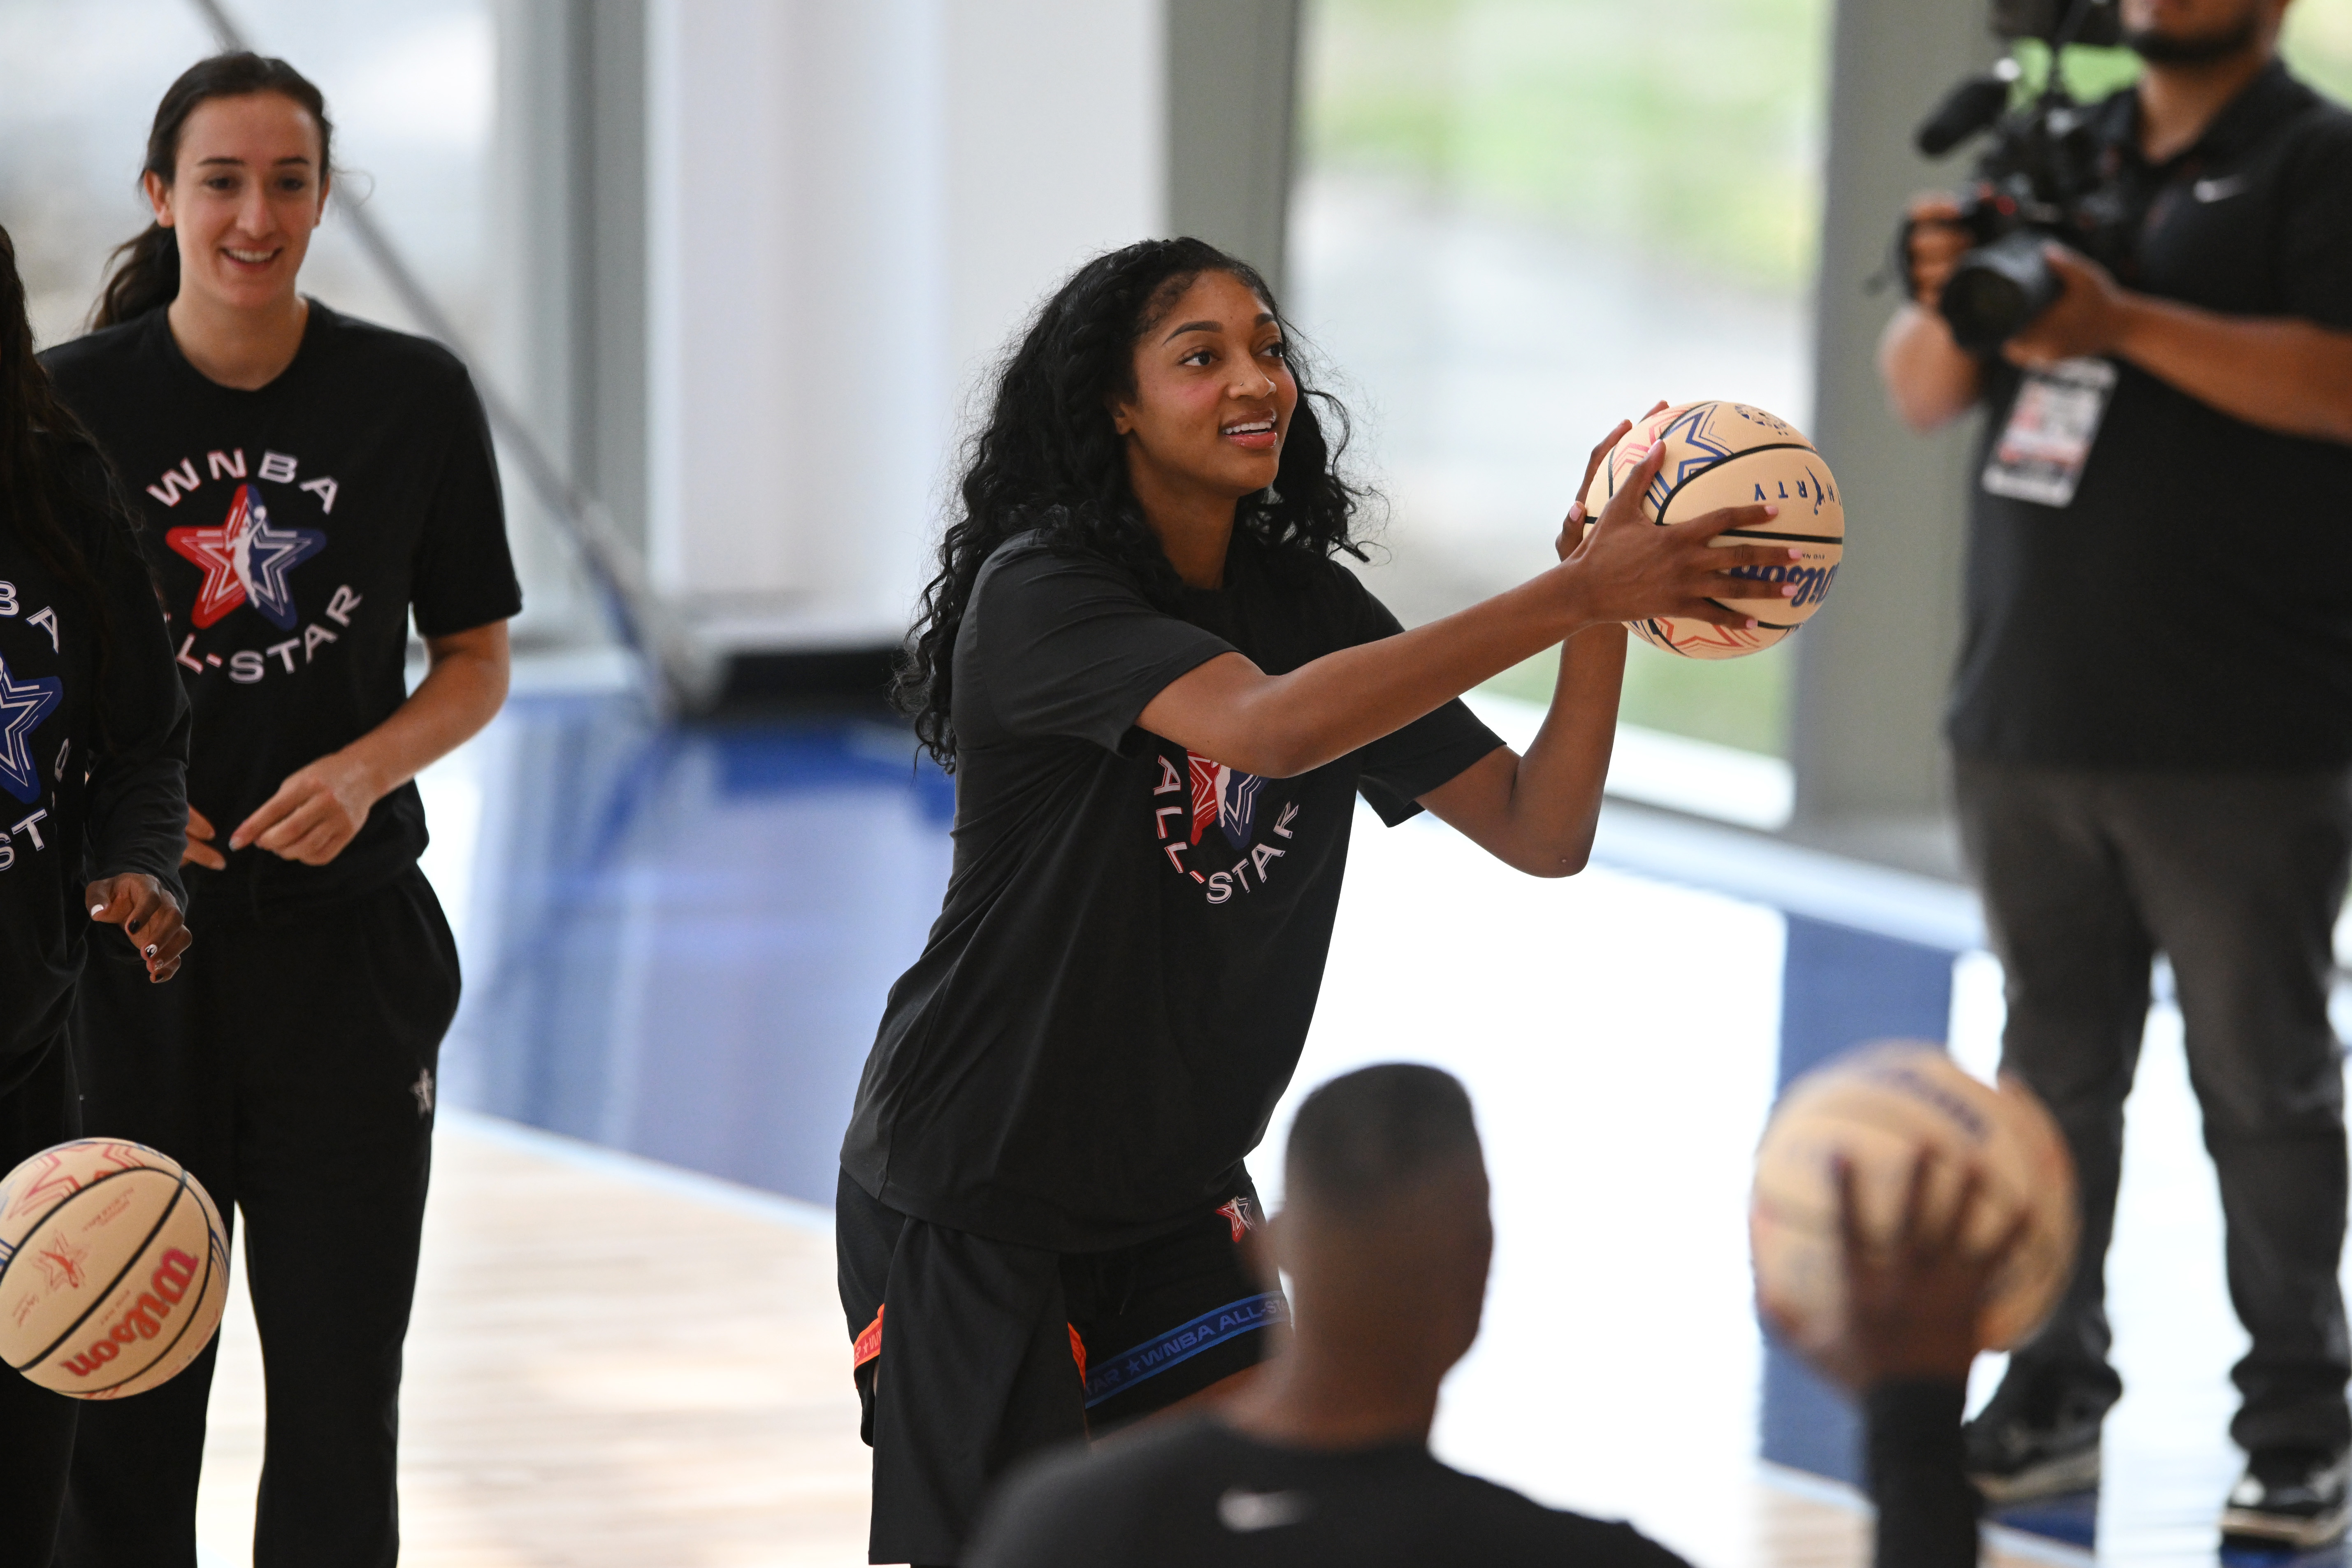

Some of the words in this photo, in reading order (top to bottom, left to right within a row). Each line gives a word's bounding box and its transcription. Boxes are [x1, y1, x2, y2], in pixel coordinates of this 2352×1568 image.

[146, 448, 338, 515] WNBA
[163, 584, 363, 684] L-STAR
[1153, 755, 1299, 904] ALL-STAR
[60, 1248, 199, 1376] Wilson
[1140, 1325, 1215, 1366] WNBA
